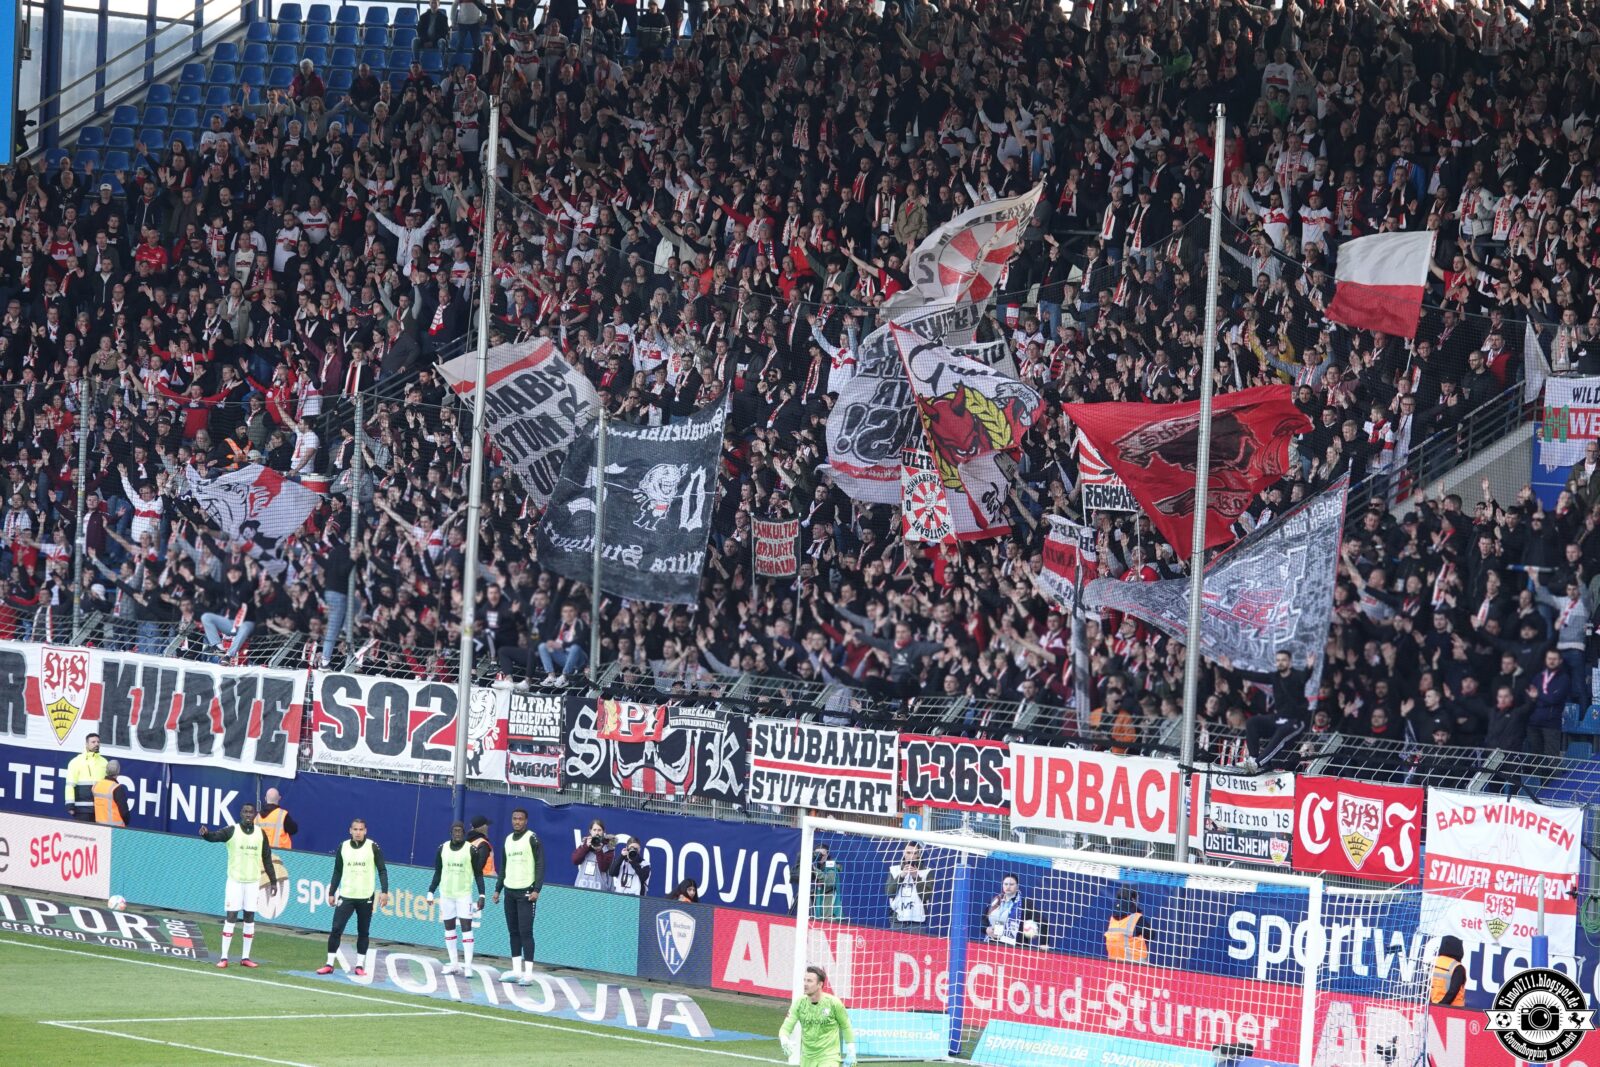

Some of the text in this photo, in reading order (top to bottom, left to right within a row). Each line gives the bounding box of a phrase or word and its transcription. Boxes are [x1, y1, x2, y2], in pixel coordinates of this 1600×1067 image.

[902, 451, 936, 470] ULTR
[101, 660, 295, 767] KURVE
[509, 710, 560, 725] BEDEUTET
[511, 696, 561, 713] ULTRAS
[508, 722, 560, 737] WIDERSTAND
[753, 723, 897, 770] SÜDBANDE
[751, 771, 892, 814] STUTTGART
[908, 742, 1004, 807] C36S
[1015, 755, 1200, 837] URBACH
[1215, 805, 1268, 828] Inferno
[1435, 804, 1575, 852] BAD WIMPFEN
[30, 831, 63, 868] SEC
[60, 844, 98, 882] COM
[1206, 833, 1269, 856] OSTELSHEIM
[1429, 859, 1572, 900] STAUFER SCHWABEN
[1461, 918, 1483, 930] seit
[97, 935, 138, 950] vom
[151, 942, 197, 959] Profi
[893, 951, 1280, 1051] Die Cloud-Stürmer
